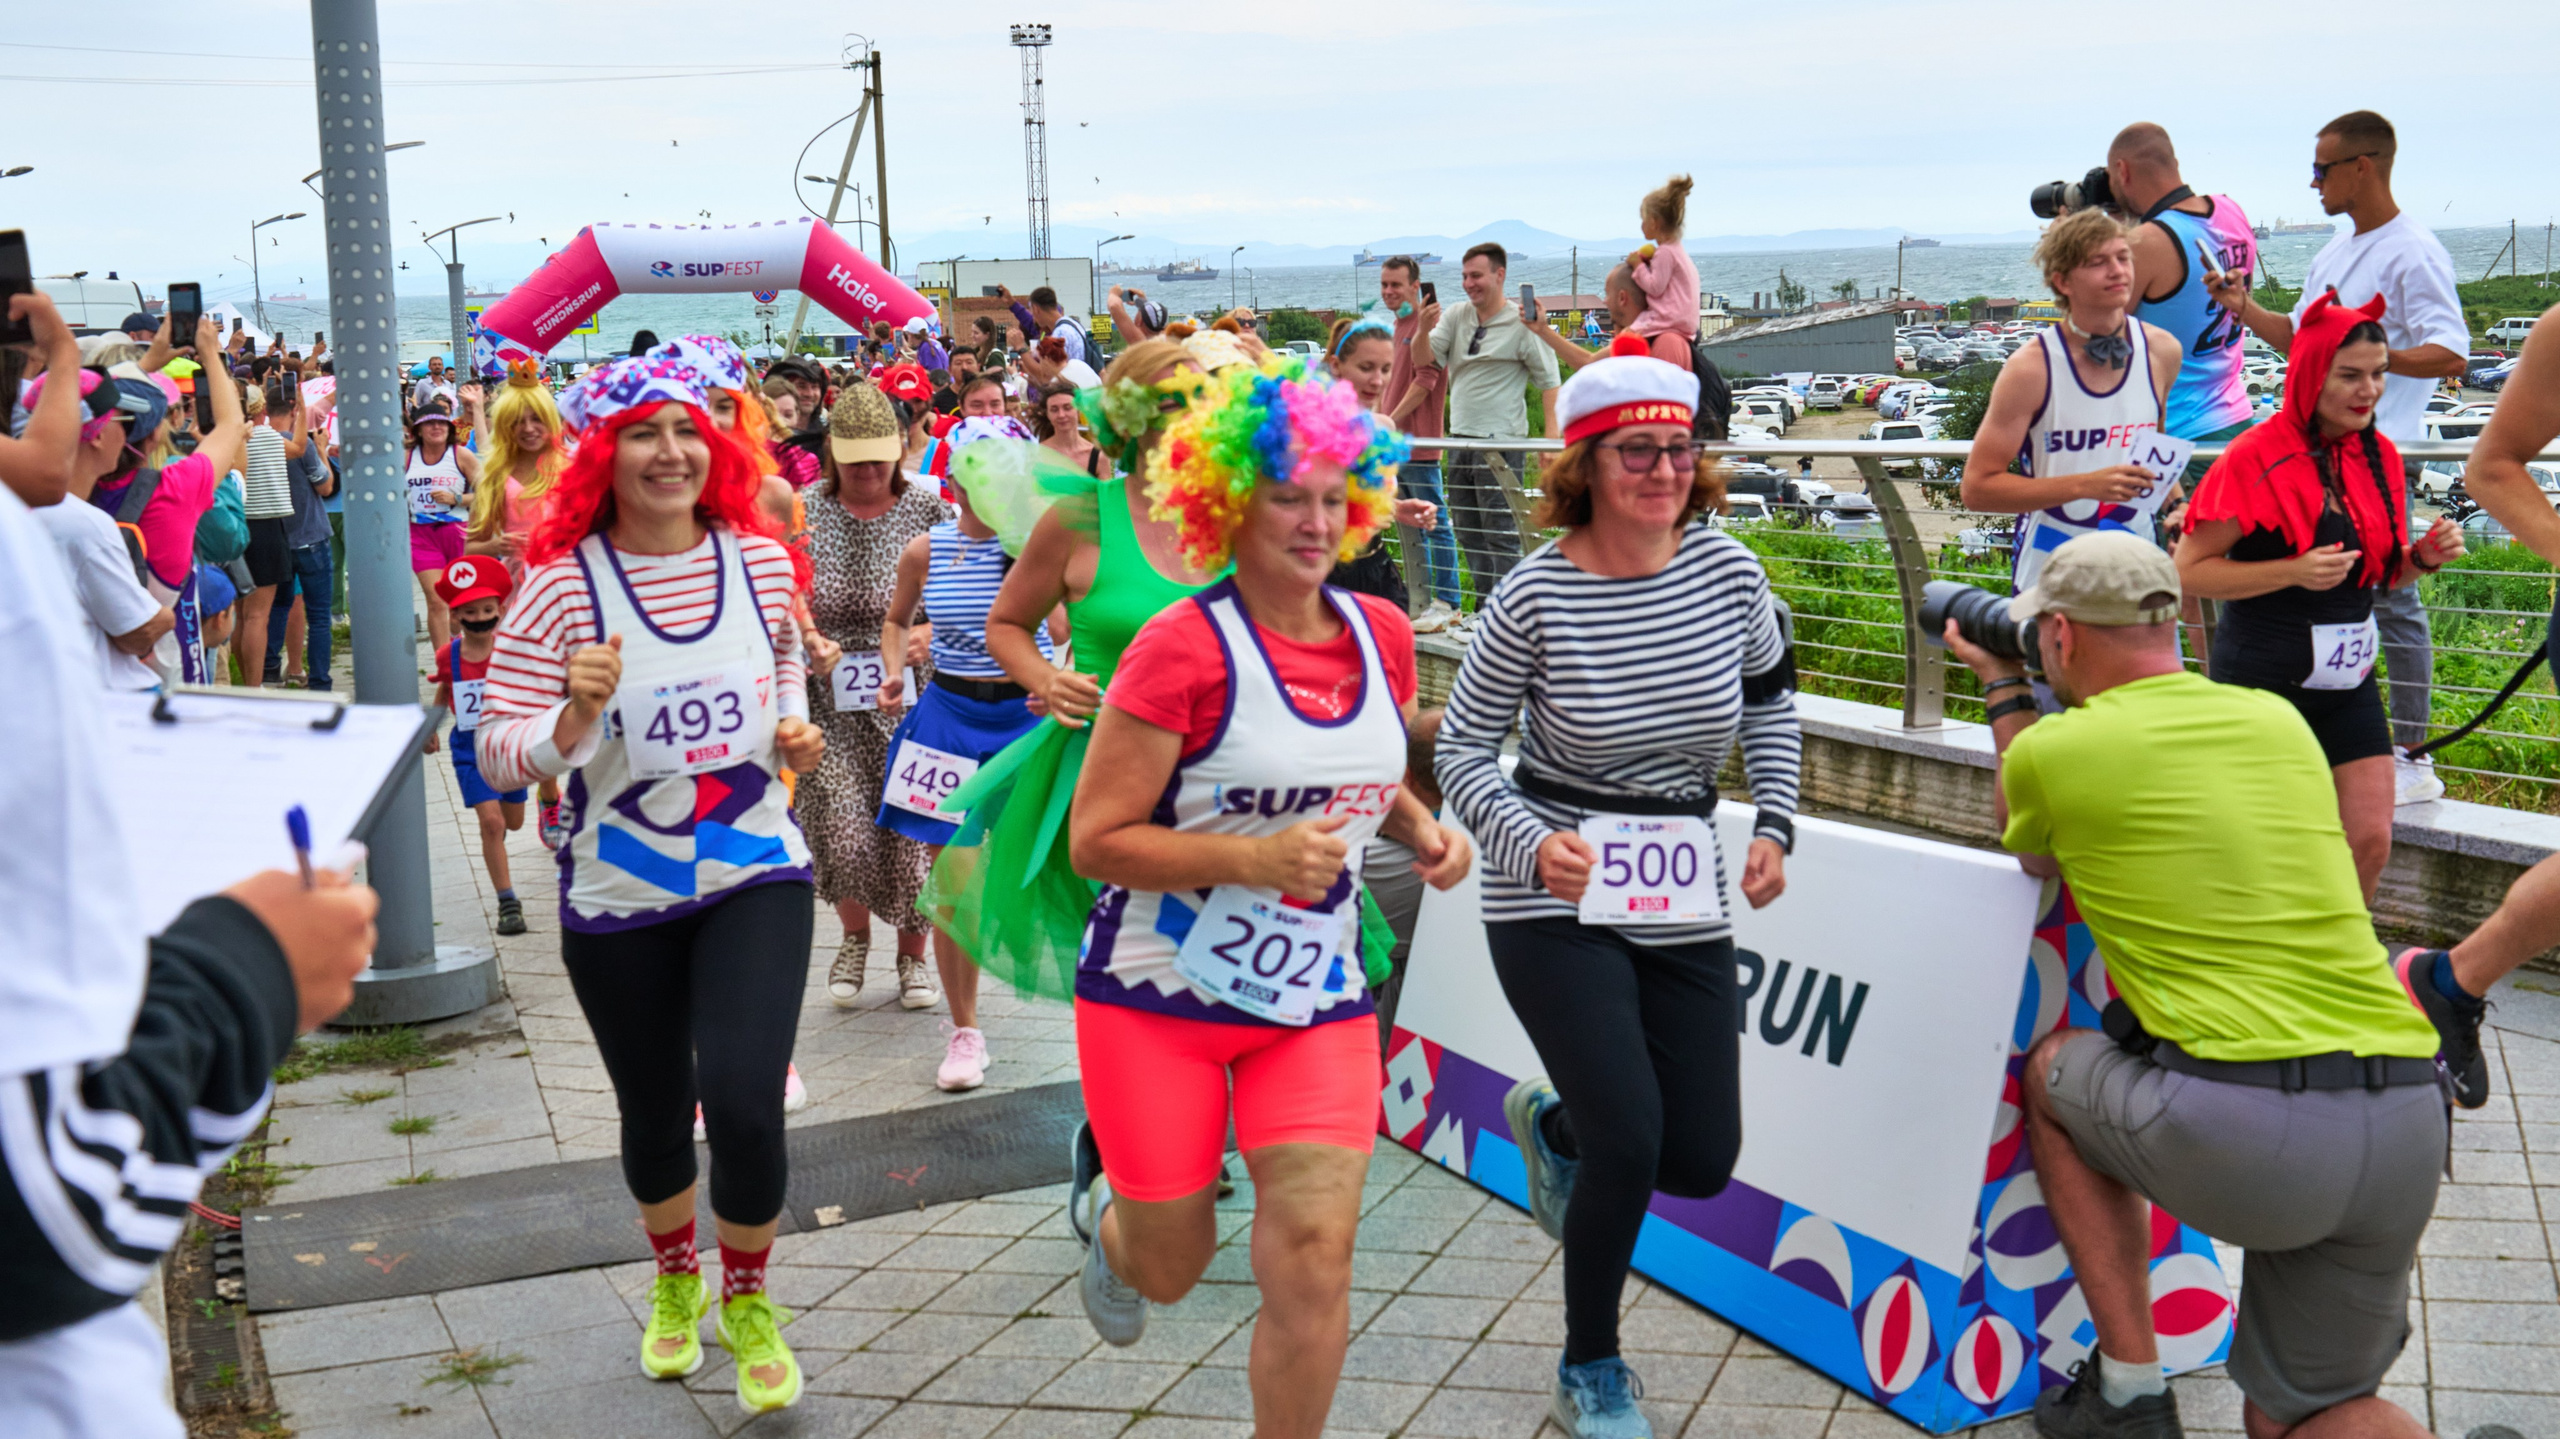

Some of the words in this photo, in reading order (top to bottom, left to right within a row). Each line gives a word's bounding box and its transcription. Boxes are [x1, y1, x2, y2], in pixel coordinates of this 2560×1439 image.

[684, 260, 764, 277] SUPFEST
[826, 263, 888, 314] Haier
[536, 281, 602, 337] RUNDNSRUN
[2047, 422, 2157, 453] SUPFE
[408, 476, 458, 488] SUPFEST
[417, 492, 436, 504] 40
[2327, 633, 2374, 671] 434
[843, 664, 883, 691] 23
[645, 691, 743, 746] 493
[900, 761, 960, 798] 449
[1220, 783, 1399, 819] SUPFES
[1603, 842, 1697, 887] 500
[1210, 915, 1322, 987] 202
[1737, 946, 1870, 1068] RUN
